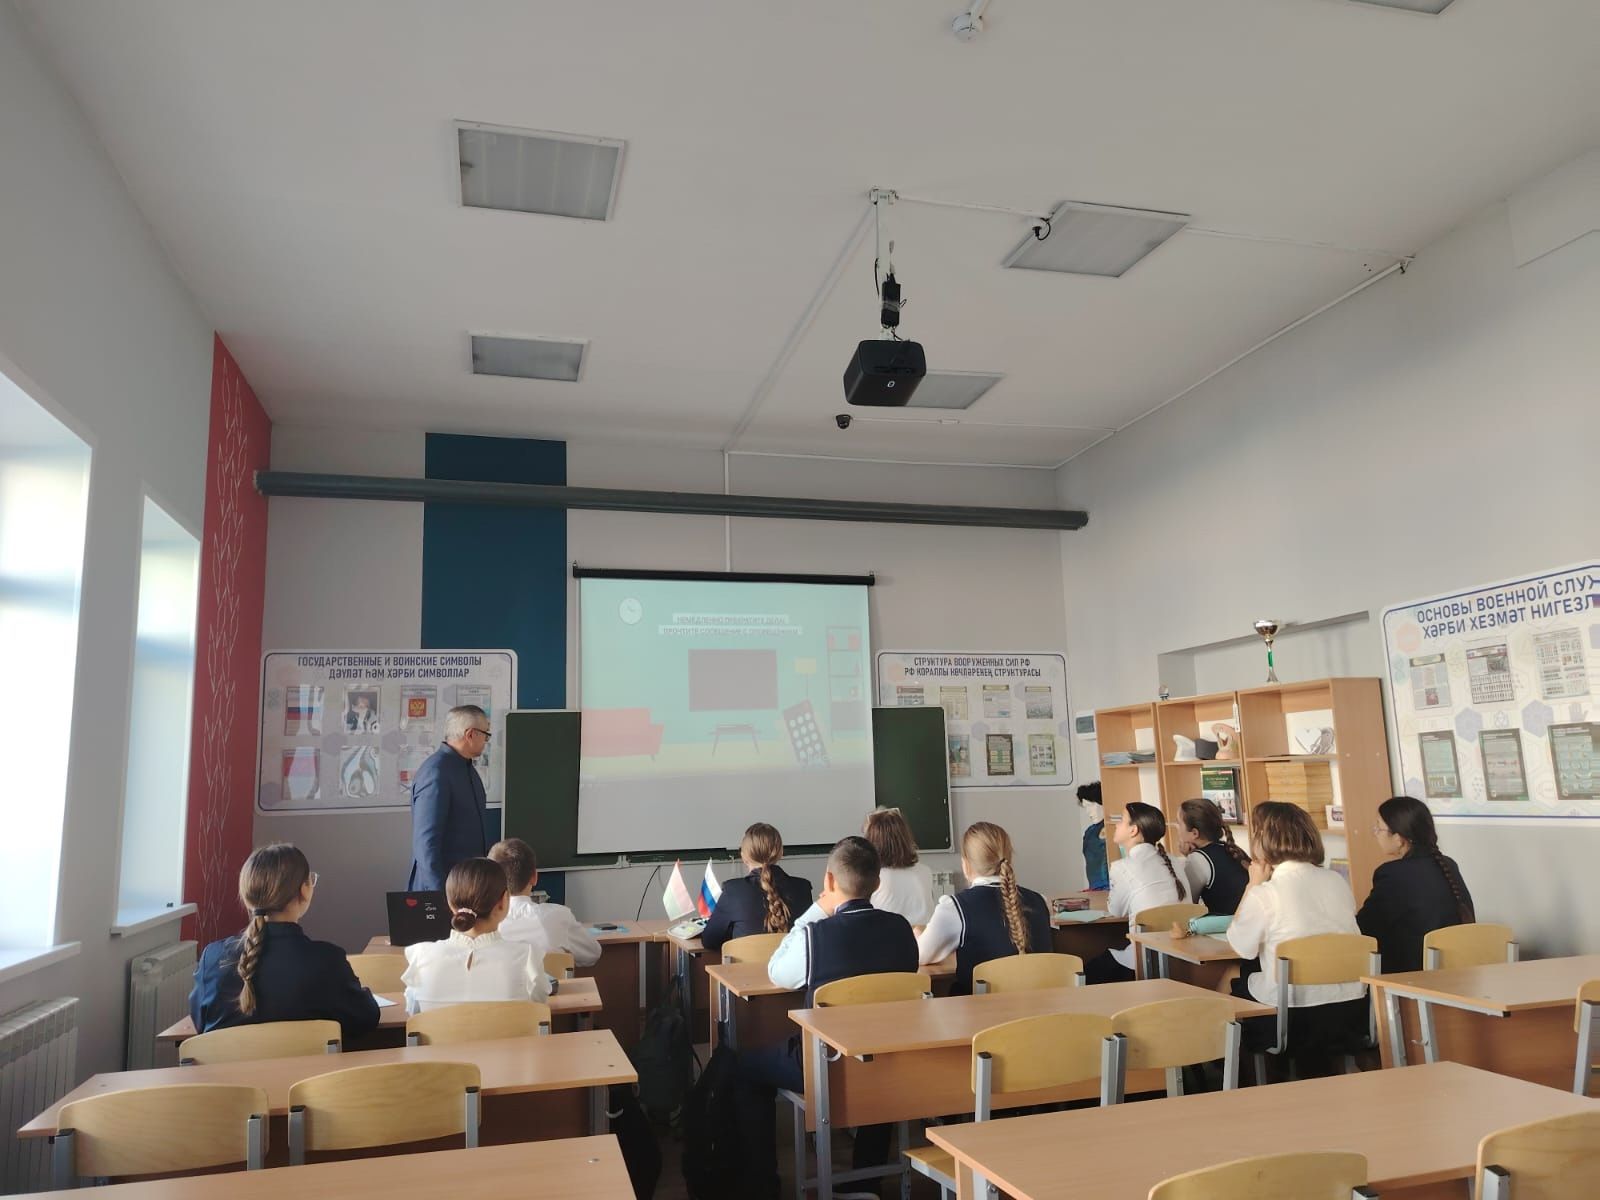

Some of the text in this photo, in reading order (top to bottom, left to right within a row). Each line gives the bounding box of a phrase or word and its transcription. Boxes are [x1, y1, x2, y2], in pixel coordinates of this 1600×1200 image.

[1417, 603, 1472, 623] ОСНОВЫ
[1476, 580, 1548, 612] ВОЕННОЙ
[1423, 618, 1466, 639] ХӘРБИ
[1469, 607, 1526, 630] ХЕЗМӘТ
[298, 656, 482, 668] ГОСУДАРСТВЕННЫЕ И ВОИНСКИЕ СИМВОЛЫ
[914, 657, 1031, 667] СТРУКТУРА ВООРУЖЕННЫХ СИЛ РФ
[387, 668, 415, 679] ХӘРБИ
[418, 668, 470, 679] СИМВОЛЛАР
[904, 667, 915, 676] РФ
[917, 667, 949, 676] КОРАЛЛЫ
[994, 668, 1041, 677] СТРУКТУРАСЫ
